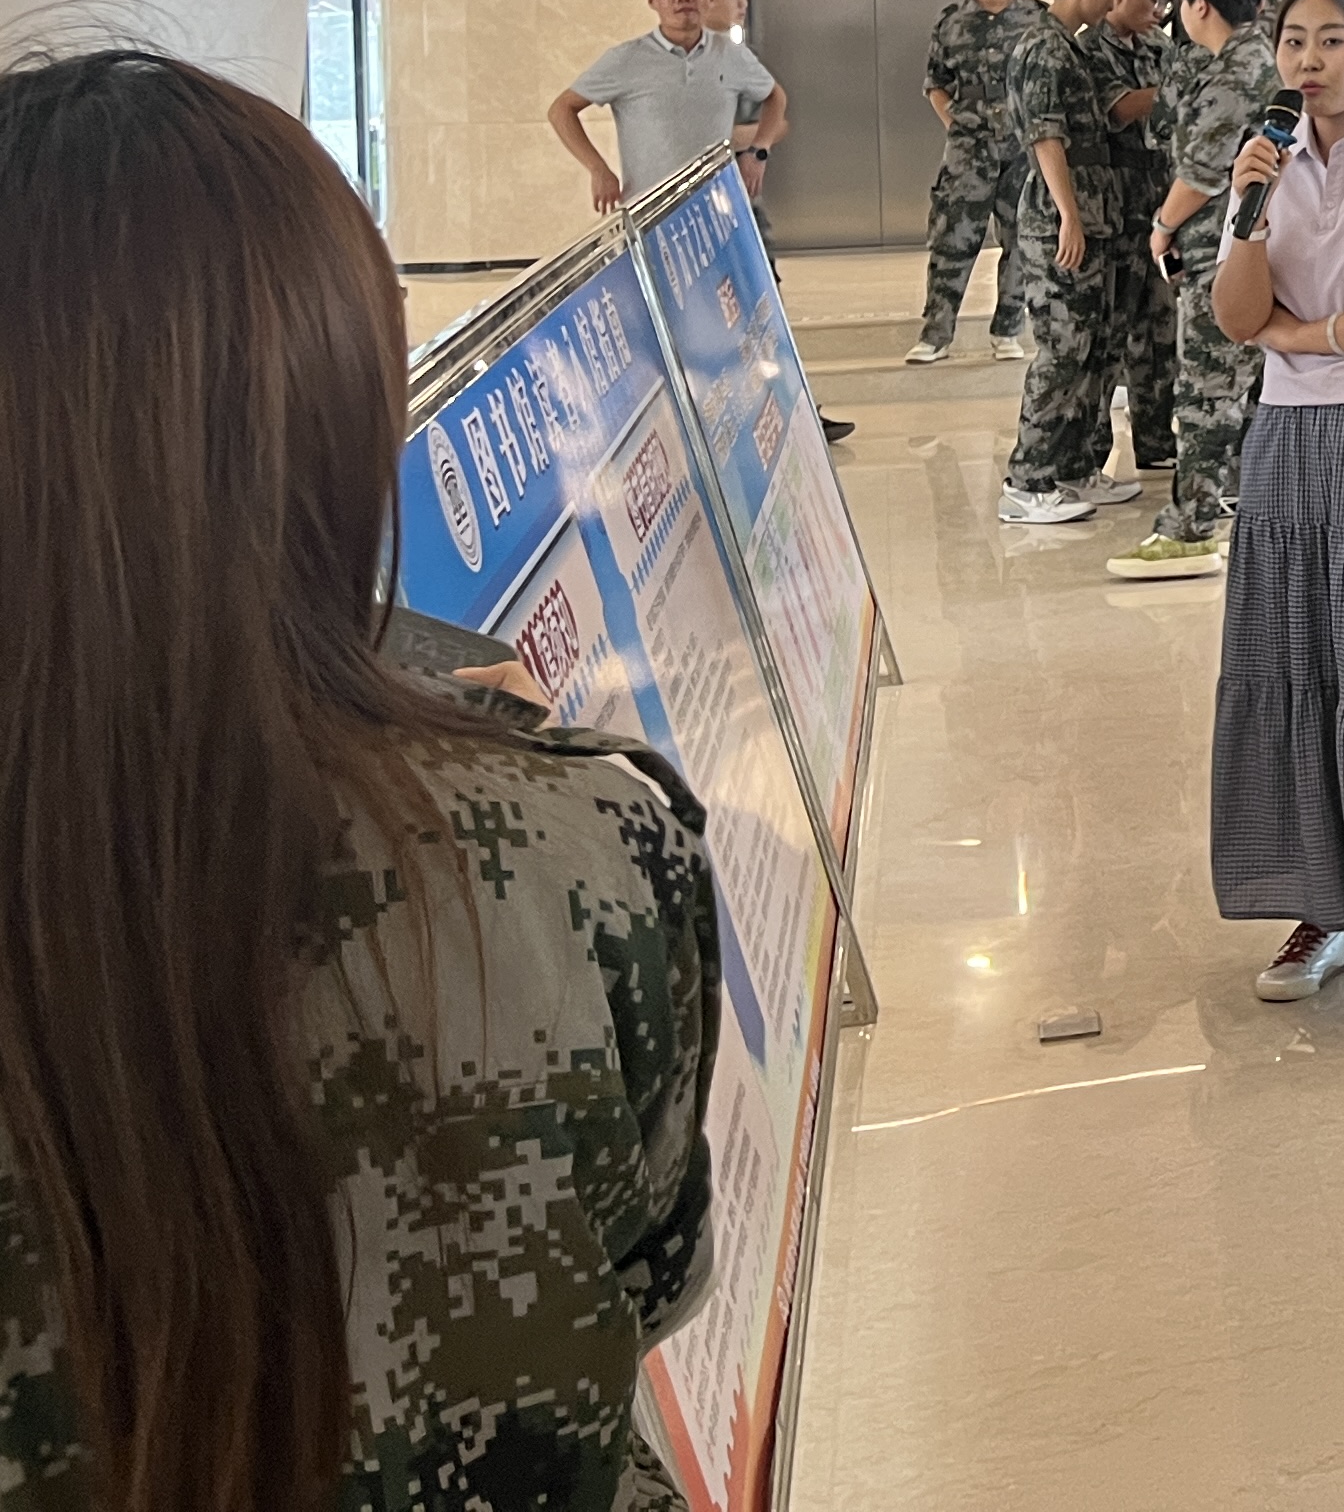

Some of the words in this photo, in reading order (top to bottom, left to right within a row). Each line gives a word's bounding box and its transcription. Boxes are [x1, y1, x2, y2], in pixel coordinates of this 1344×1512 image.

[460, 286, 632, 527] 图书馆读者入馆指南
